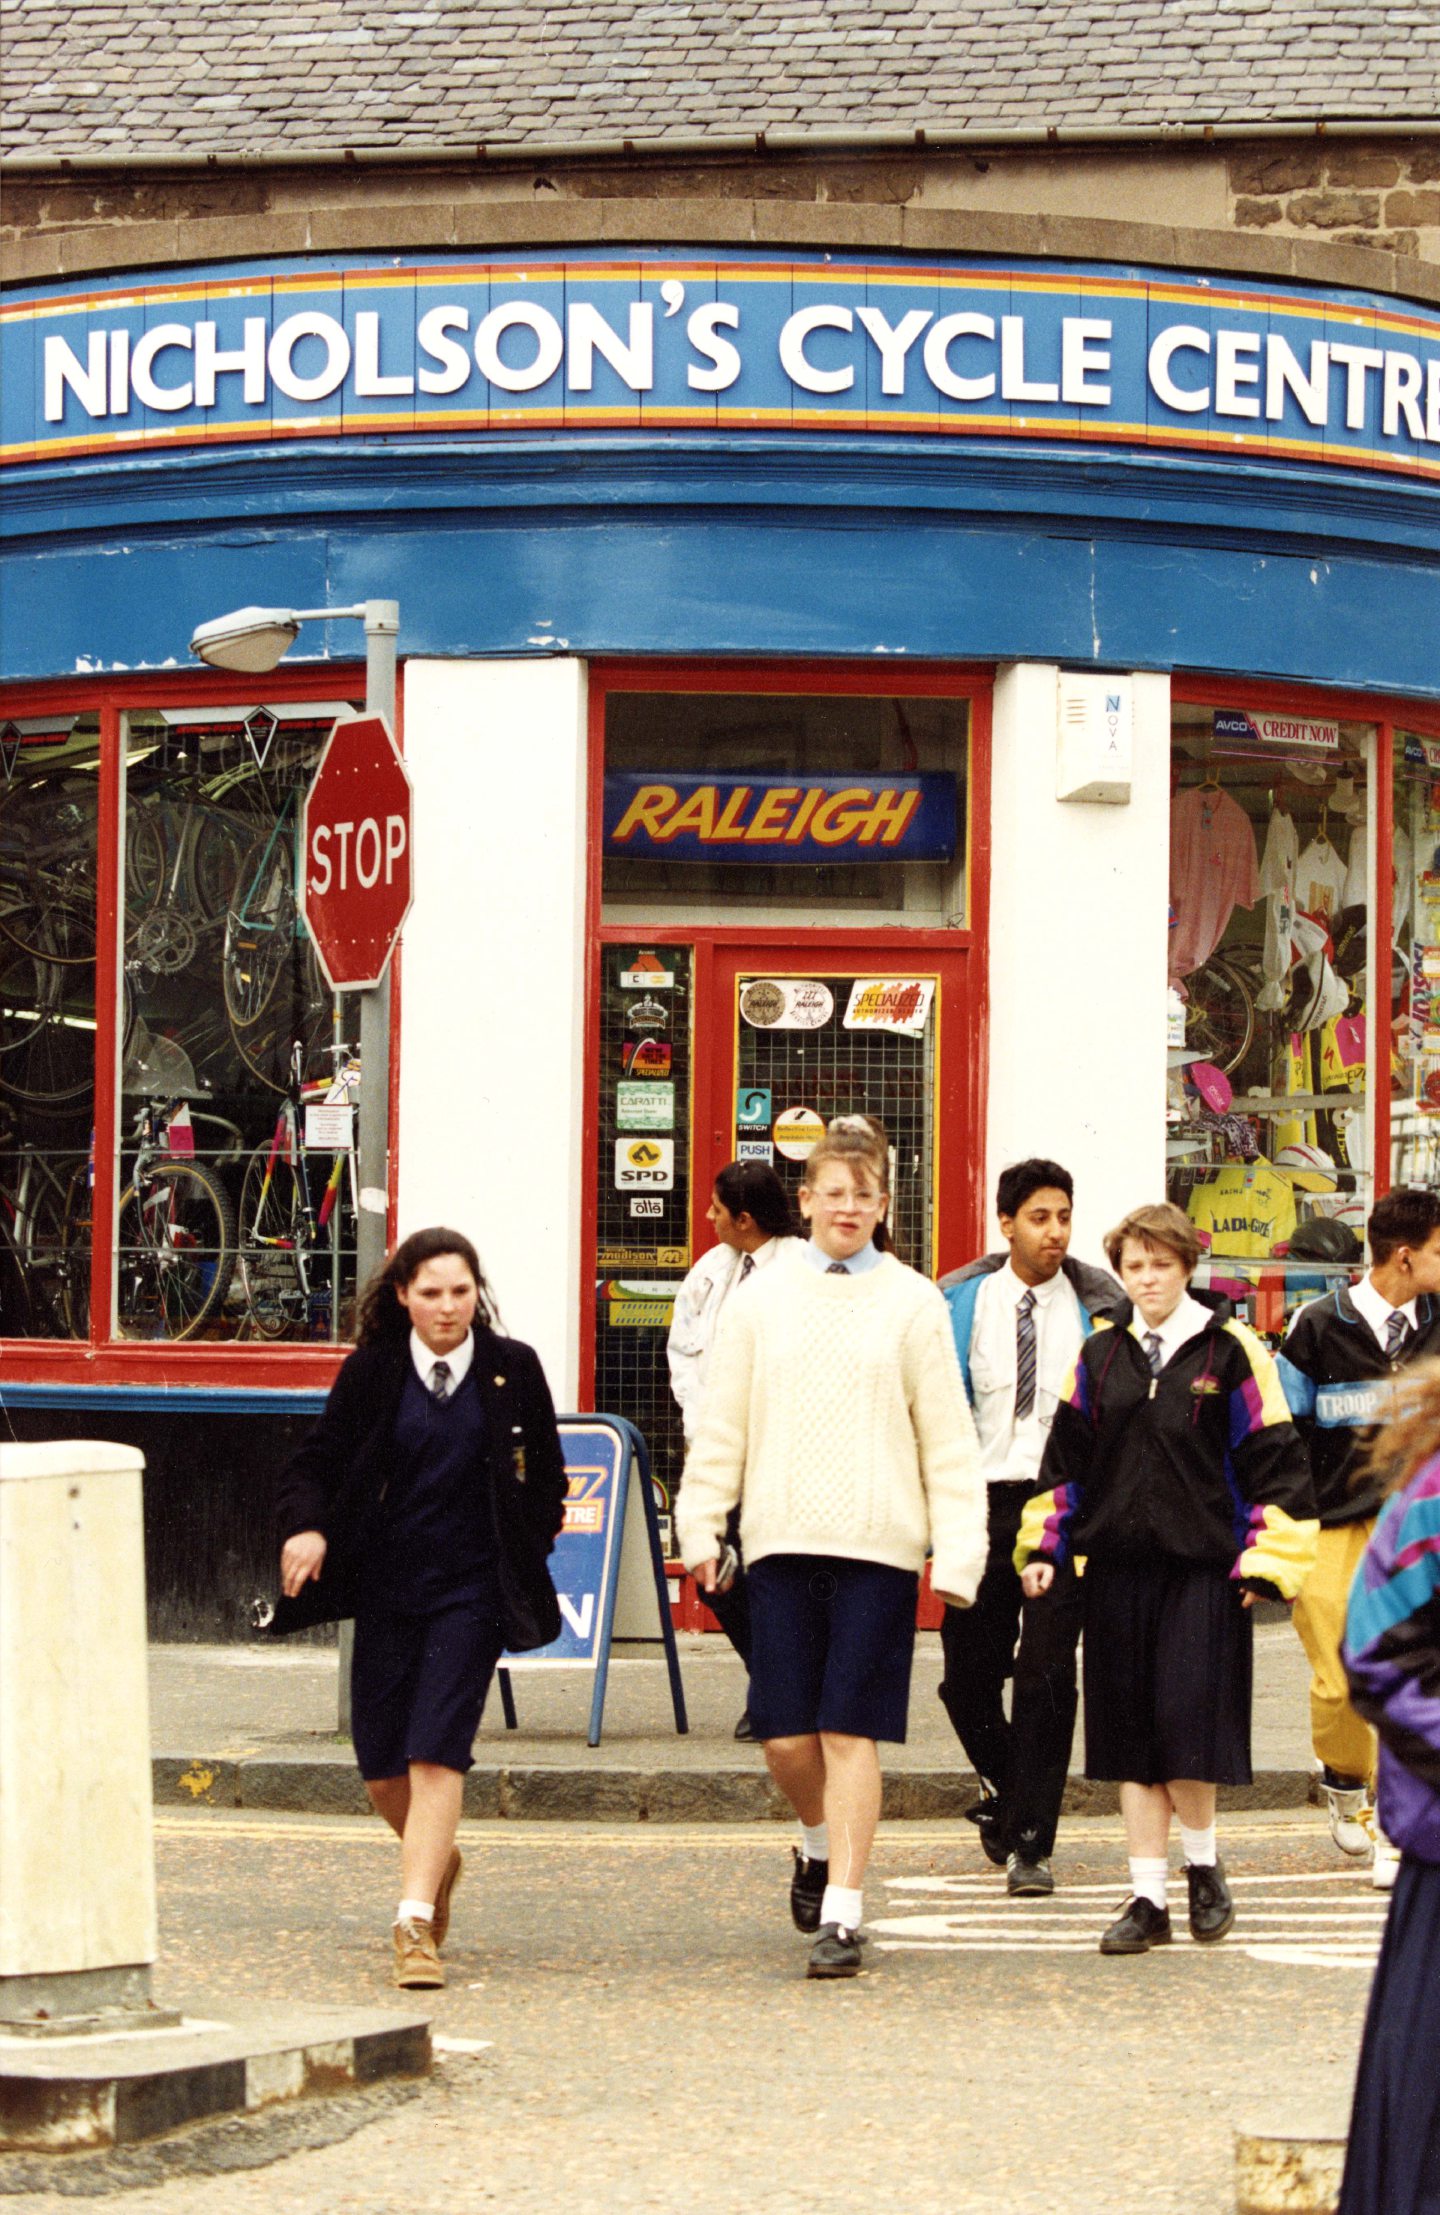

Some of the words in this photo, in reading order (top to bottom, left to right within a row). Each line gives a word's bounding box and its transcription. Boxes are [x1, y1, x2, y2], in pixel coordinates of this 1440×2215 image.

[45, 279, 741, 421] NICHOLSON’S
[779, 304, 1112, 405] CYCLE
[1106, 695, 1120, 751] NOVA
[1216, 720, 1248, 732] AVCO
[1263, 720, 1308, 740] CREDIT
[1309, 726, 1337, 743] NOW
[611, 785, 922, 846] RALEIGH
[311, 815, 406, 895] STOP
[853, 994, 925, 1006] SPECIALIZED
[740, 1144, 770, 1155] PUSH
[621, 1170, 668, 1181] SPD
[1317, 1391, 1377, 1419] TROOP
